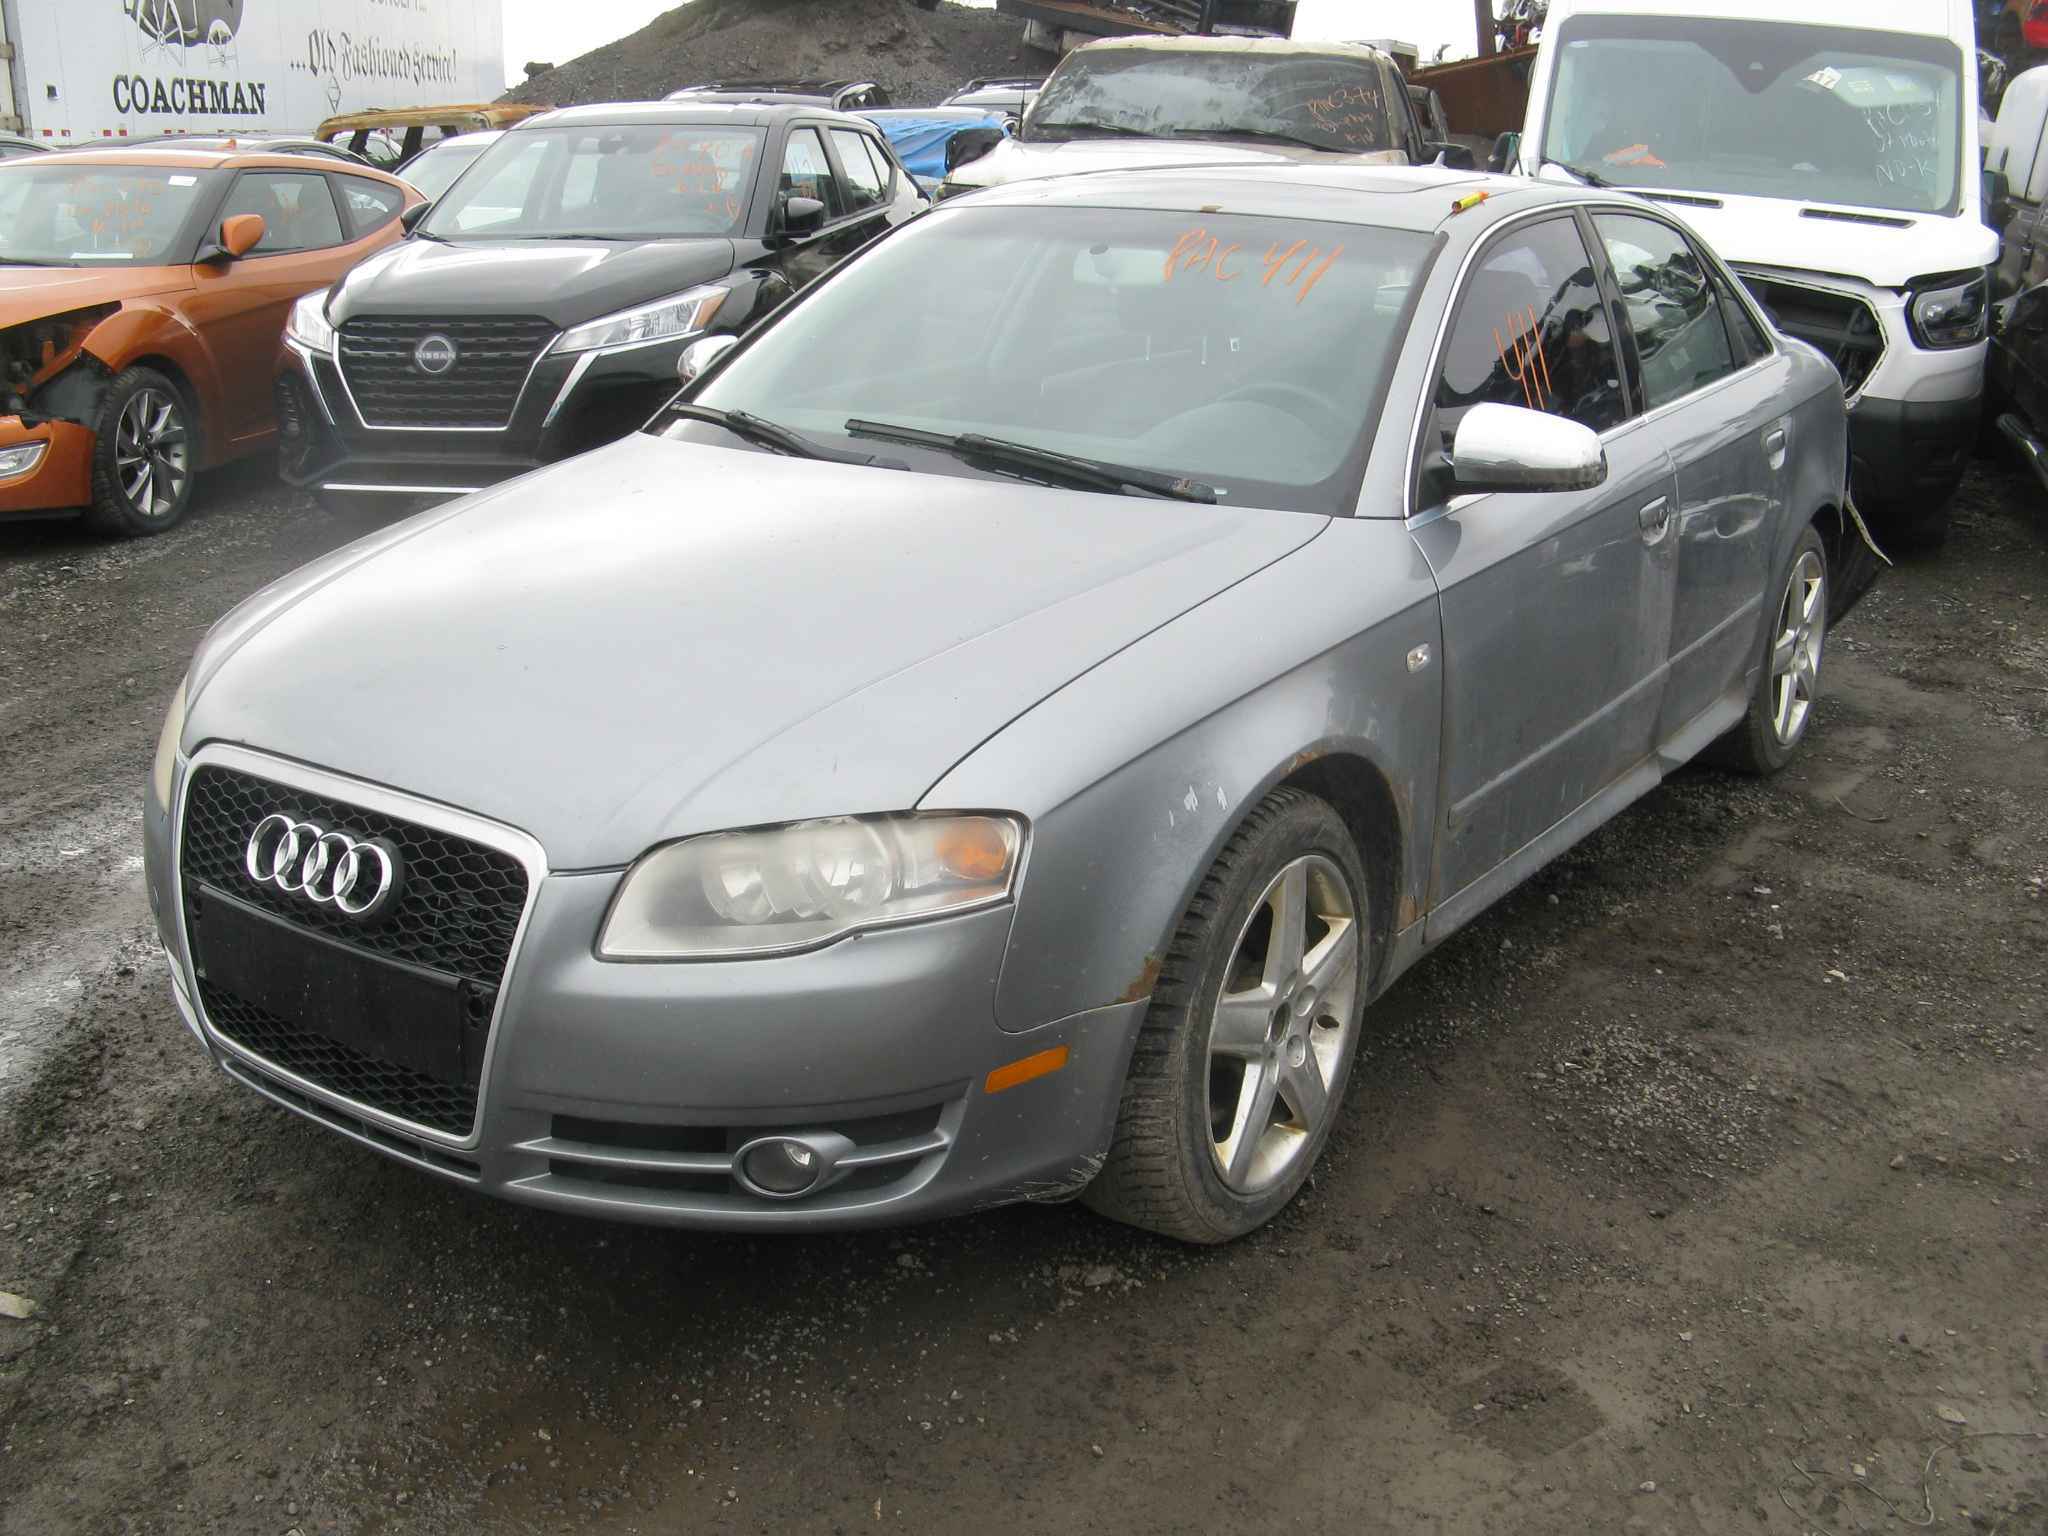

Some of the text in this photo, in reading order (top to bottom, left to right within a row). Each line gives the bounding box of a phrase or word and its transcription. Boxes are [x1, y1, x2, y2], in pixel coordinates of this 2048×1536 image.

[340, 31, 410, 81] Fashioned
[113, 74, 266, 115] COACHMAN
[415, 352, 456, 360] NISSAN
